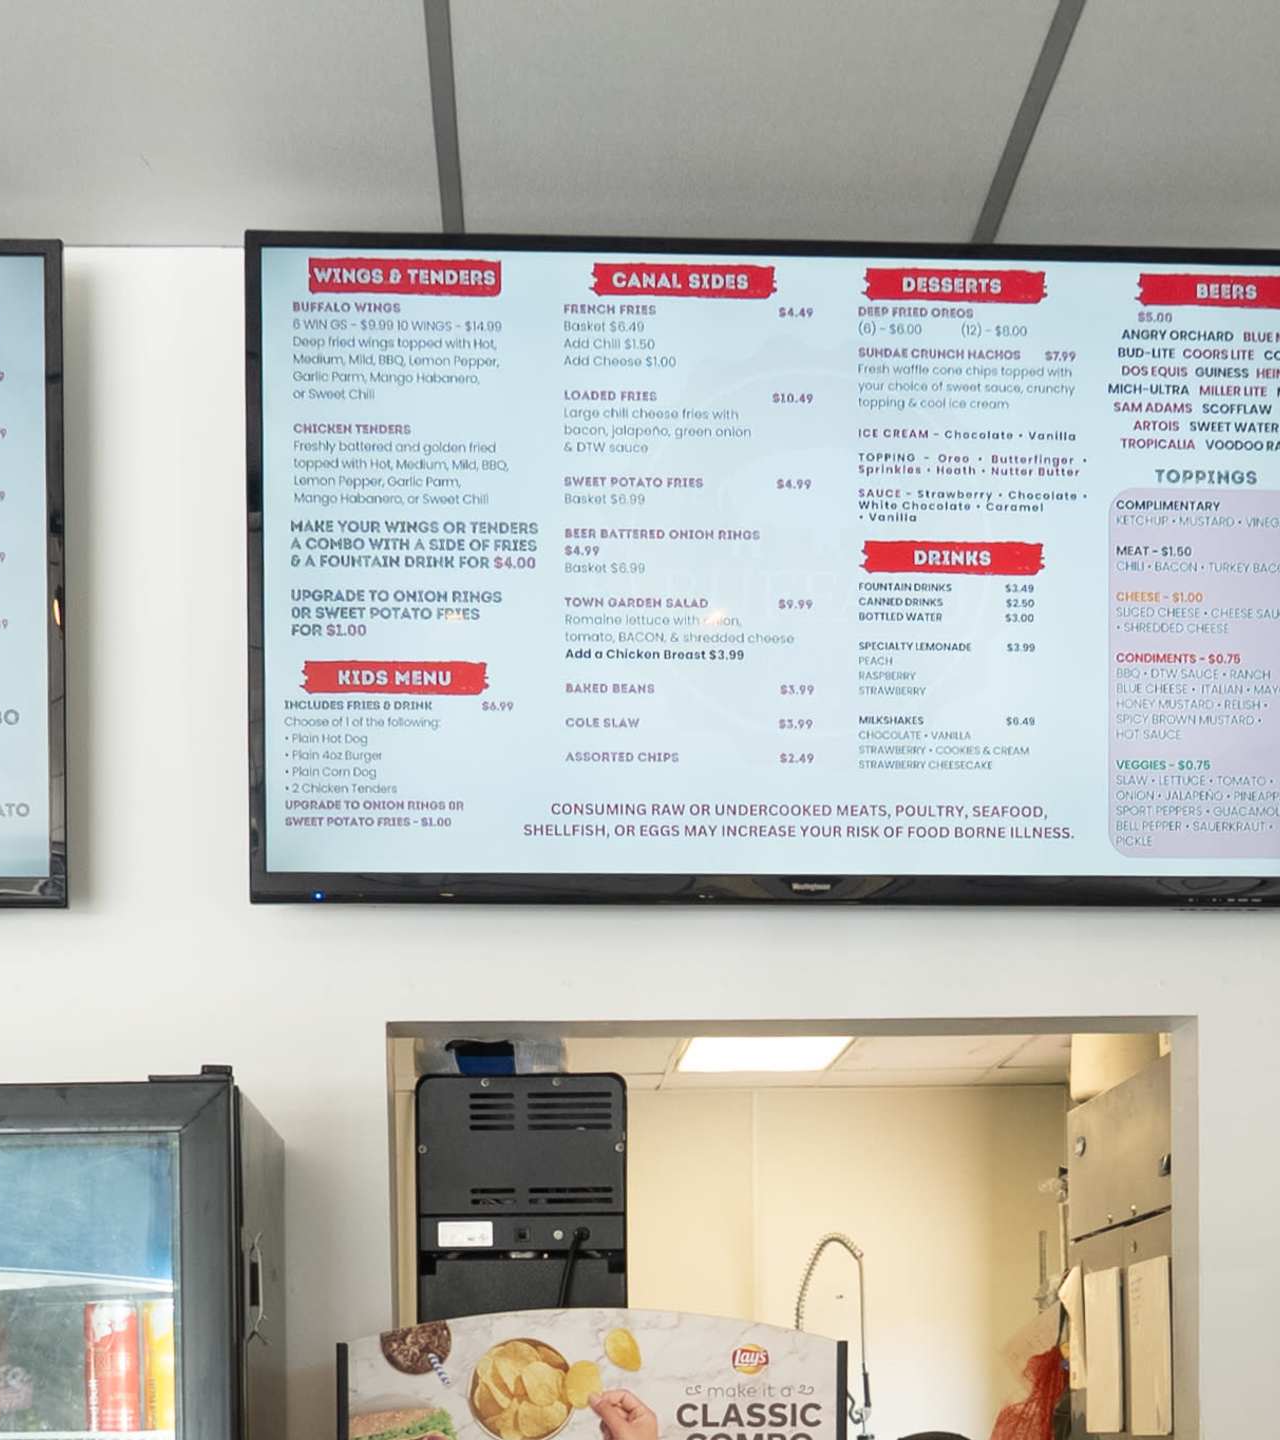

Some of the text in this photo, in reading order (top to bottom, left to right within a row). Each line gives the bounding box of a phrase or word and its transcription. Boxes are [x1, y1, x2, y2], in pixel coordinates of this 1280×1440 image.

[312, 268, 495, 285] WINGS & TENDERS
[612, 272, 751, 289] CANAL SIDES
[901, 277, 1002, 294] DESSERTS
[1195, 282, 1258, 300] BEERS
[564, 304, 813, 317] FRENCH FRIES $4.49
[1122, 329, 1166, 340] ANGRY
[1169, 330, 1234, 341] ORCHARD
[1243, 332, 1272, 342] BLUE
[1118, 347, 1174, 358] BUD-LITE
[1183, 349, 1228, 360] COORS
[1231, 350, 1253, 360] LITE
[1122, 366, 1148, 376] DOS
[1151, 366, 1187, 377] EQUIS
[1195, 367, 1249, 378] GUINESS
[1155, 469, 1257, 485] TOPPINGS
[1116, 500, 1220, 511] COMPLIMENTARY
[291, 520, 538, 534] MAKE YOUR WINGS OR TENDERS
[912, 549, 992, 567] DRINKS
[339, 670, 453, 687] KIDS MENU
[551, 803, 1047, 820] CONSUMING RAW OR UNDERCOOKED MEATS, POULTRY, SEAFOOD,
[524, 824, 1074, 839] SHELLFISH, OR EGGS MAY INCREASE YOUR RISK OF FOOD BORNE ILLNESS.
[708, 1383, 792, 1398] make it a
[676, 1403, 822, 1428] CLASSIC
